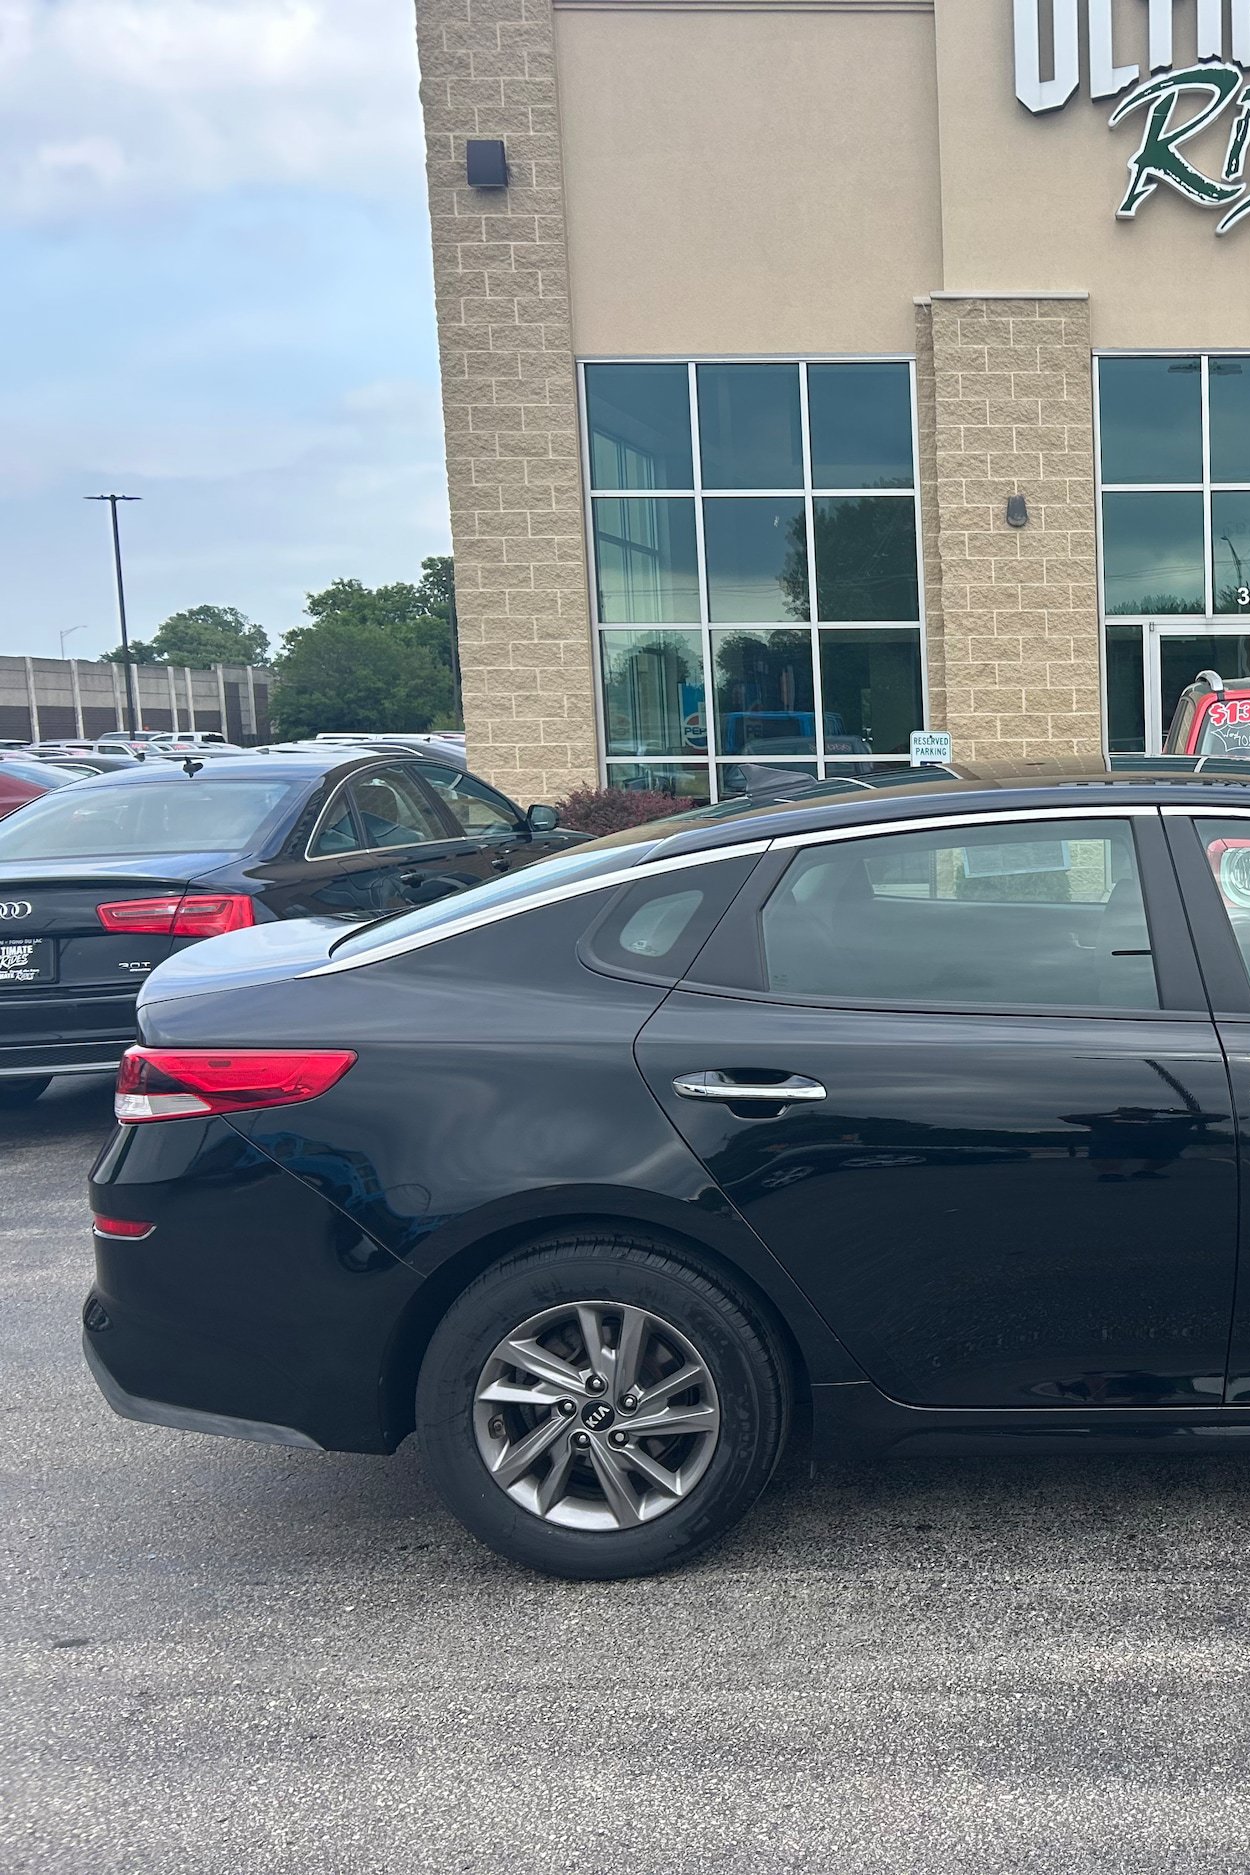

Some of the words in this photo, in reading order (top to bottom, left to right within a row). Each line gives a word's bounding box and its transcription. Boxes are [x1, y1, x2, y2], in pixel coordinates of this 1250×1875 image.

[684, 726, 708, 736] PEP
[913, 736, 949, 746] RESERVED
[915, 747, 947, 756] PARKING
[585, 1405, 611, 1428] KIA
